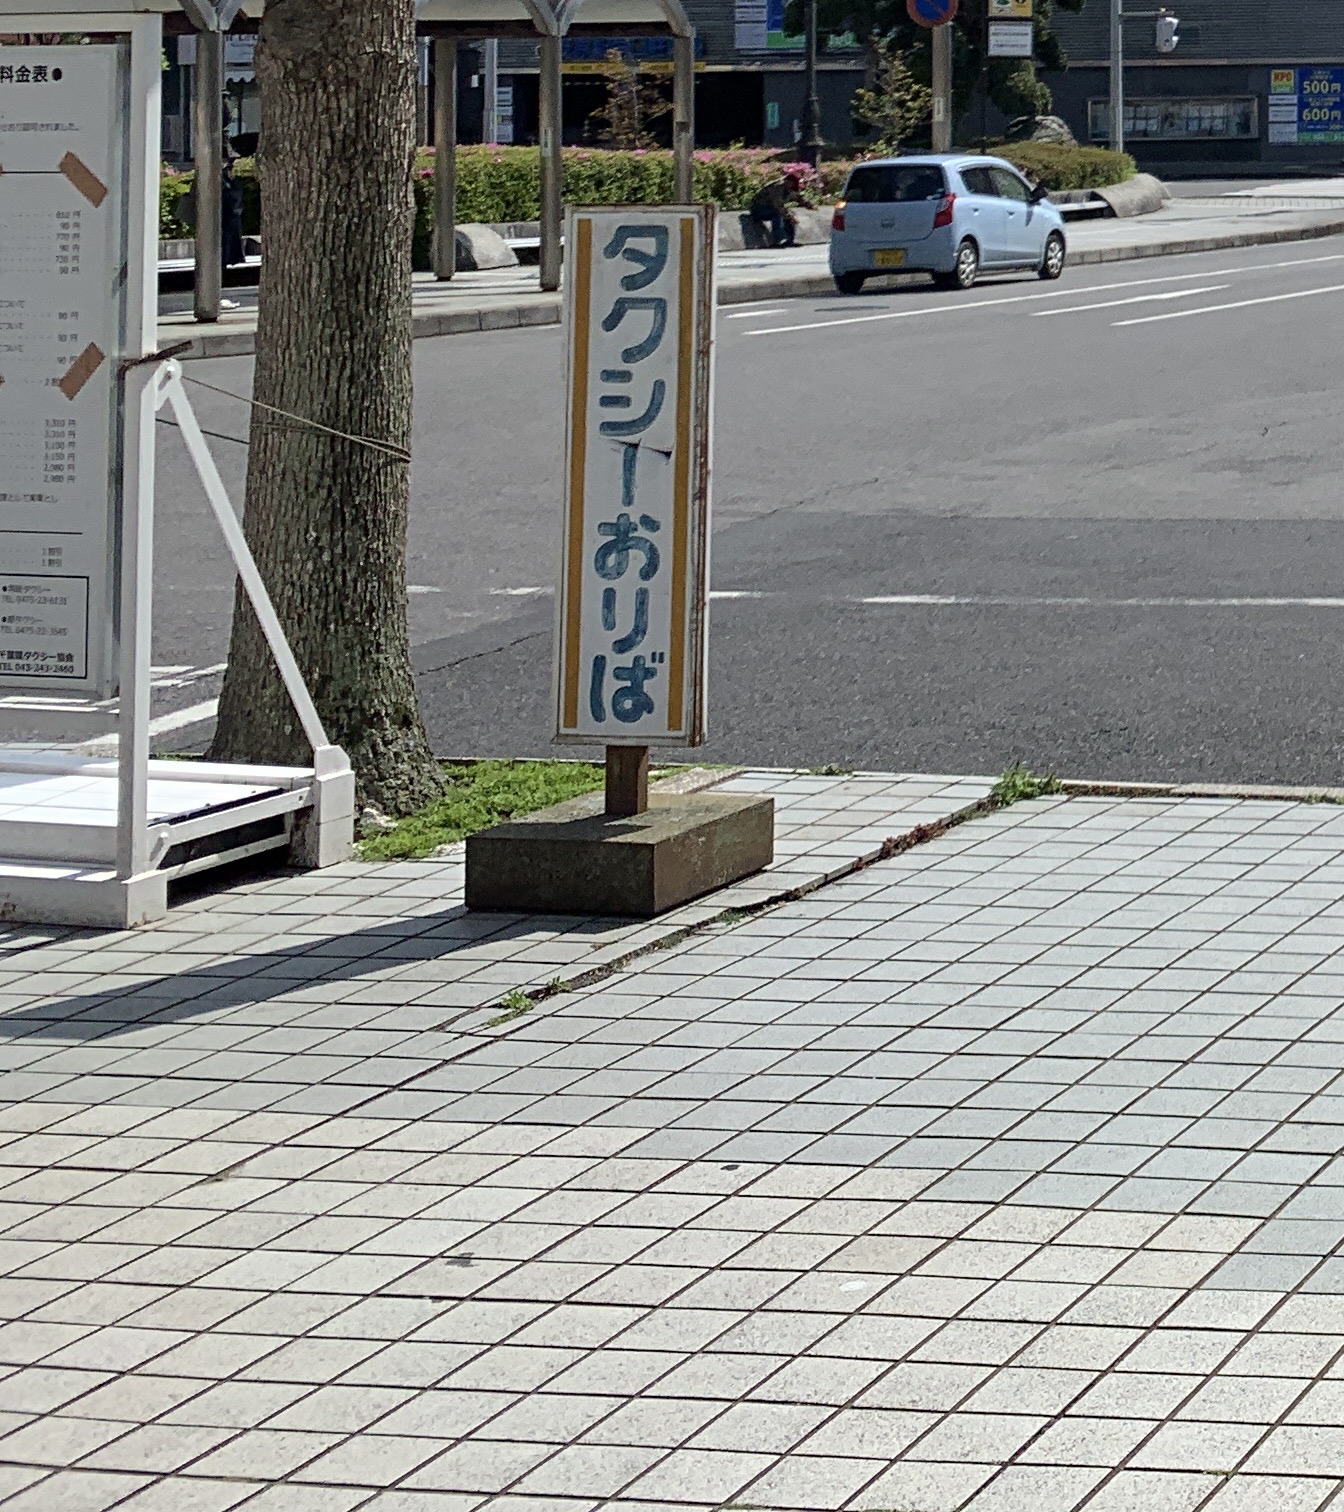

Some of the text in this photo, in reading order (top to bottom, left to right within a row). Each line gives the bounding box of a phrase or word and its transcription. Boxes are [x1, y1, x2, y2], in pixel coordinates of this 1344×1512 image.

[0, 65, 48, 83] 料金表
[1303, 81, 1341, 94] 500円
[590, 222, 672, 726] タクシーおりば
